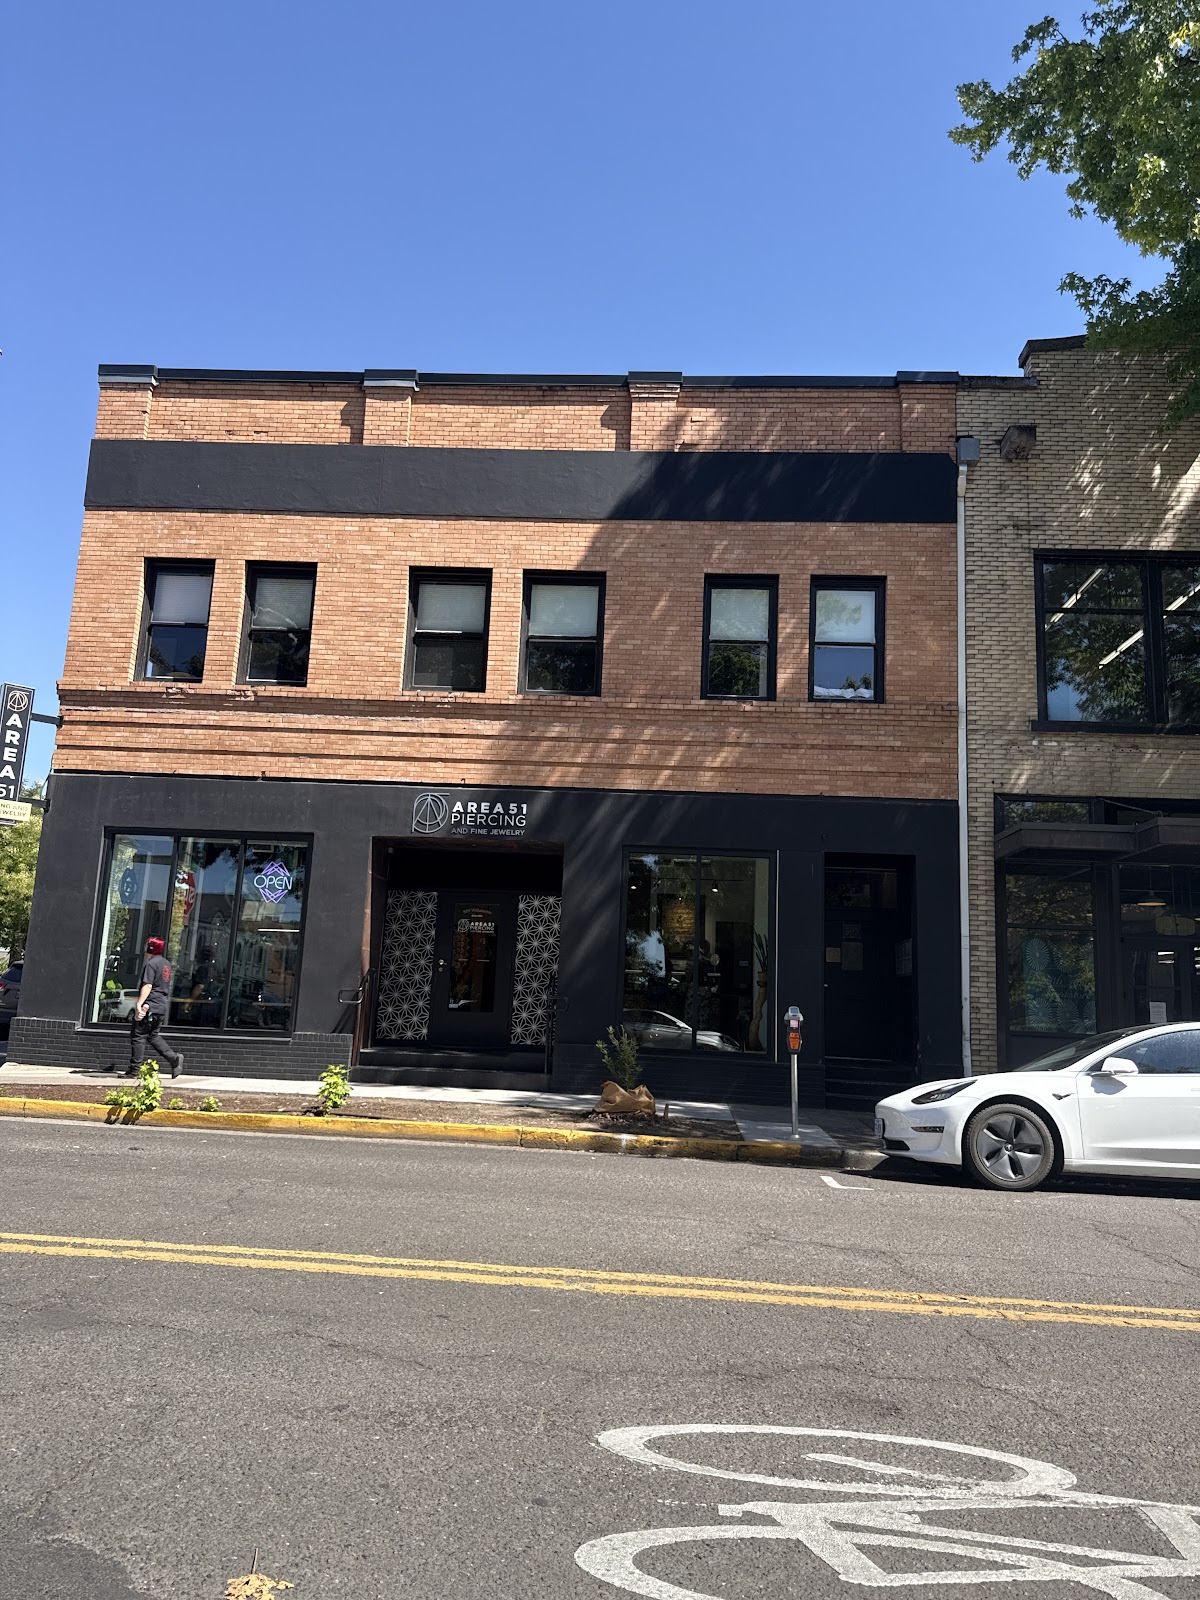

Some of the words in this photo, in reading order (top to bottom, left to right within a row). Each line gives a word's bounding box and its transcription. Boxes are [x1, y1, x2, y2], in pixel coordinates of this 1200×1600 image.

[0, 713, 23, 780] AREA
[0, 783, 15, 799] 51
[452, 801, 504, 813] AREA
[508, 803, 527, 814] 51
[451, 813, 526, 826] PIERCING
[490, 828, 525, 836] JEWELRY
[254, 875, 292, 890] OPEN
